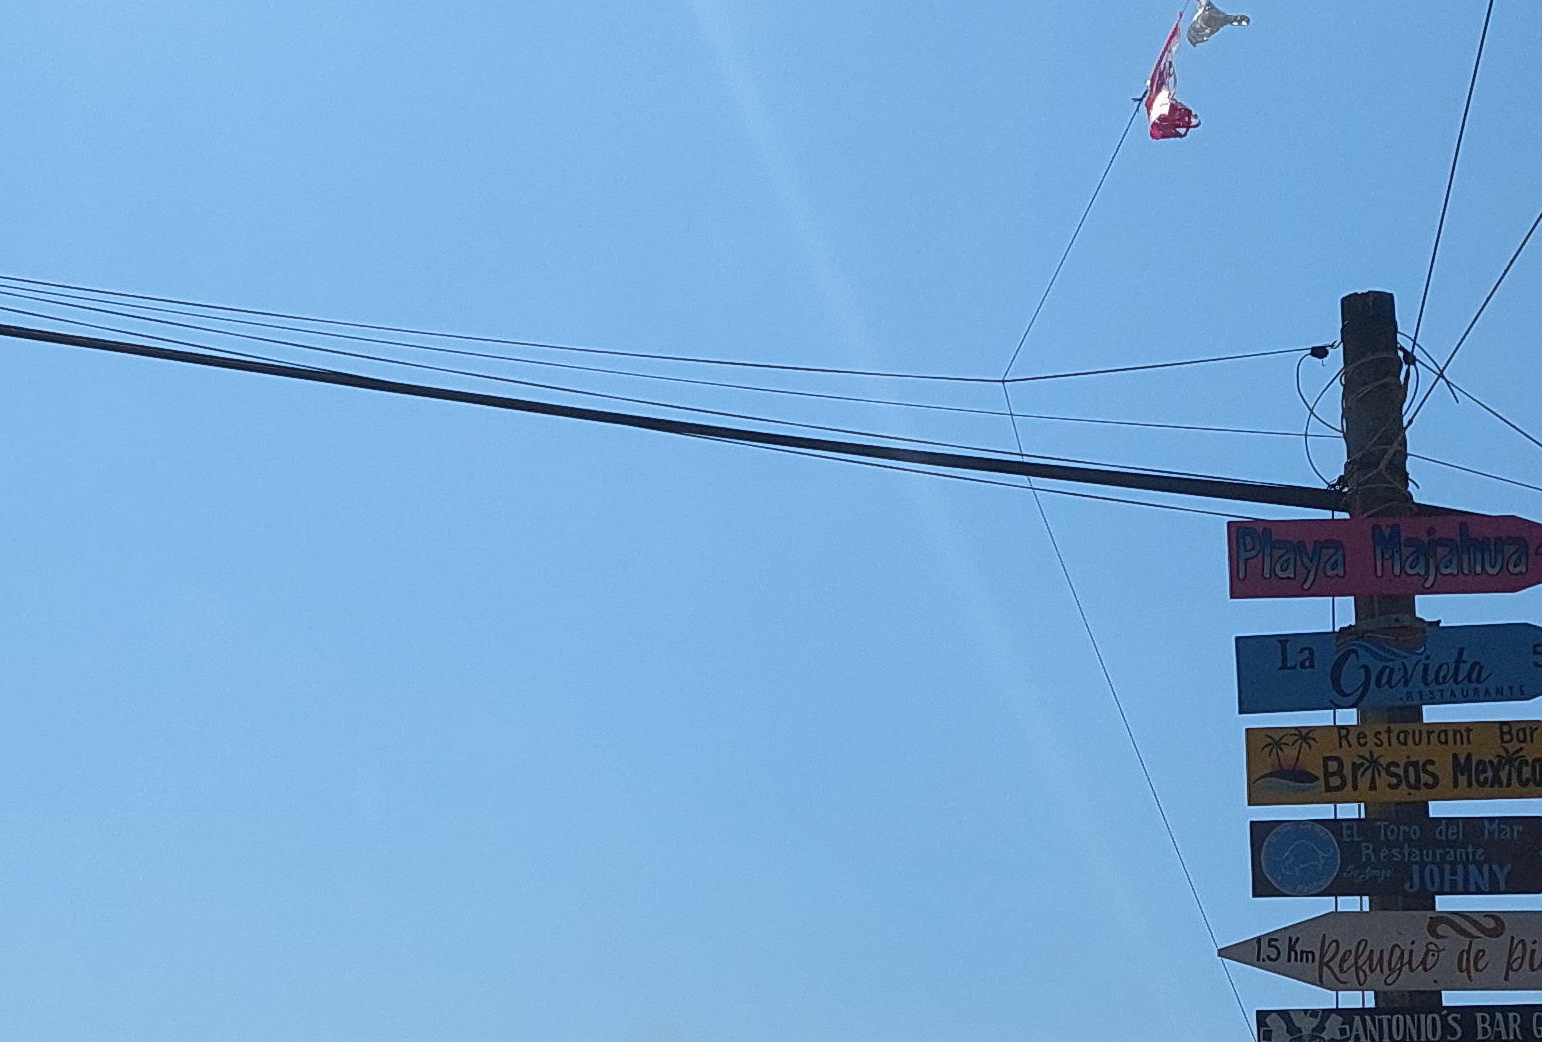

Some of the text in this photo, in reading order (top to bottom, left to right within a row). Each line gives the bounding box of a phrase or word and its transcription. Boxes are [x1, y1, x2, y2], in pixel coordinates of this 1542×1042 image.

[1235, 522, 1530, 590] Playa Majahua
[1278, 639, 1494, 709] La Gaviota
[1337, 722, 1539, 749] Restaurant Bar
[1322, 749, 1440, 793] Brisas
[1377, 820, 1421, 840] Toro
[1435, 819, 1465, 840] del
[1483, 820, 1524, 839] Mar
[1361, 843, 1486, 863] Restaurante
[1403, 863, 1513, 892] JOHNY
[1255, 936, 1316, 964] 1.5 Km
[1317, 937, 1445, 986] Refugio
[1457, 938, 1489, 982] de
[1476, 1011, 1524, 1041] BAR
